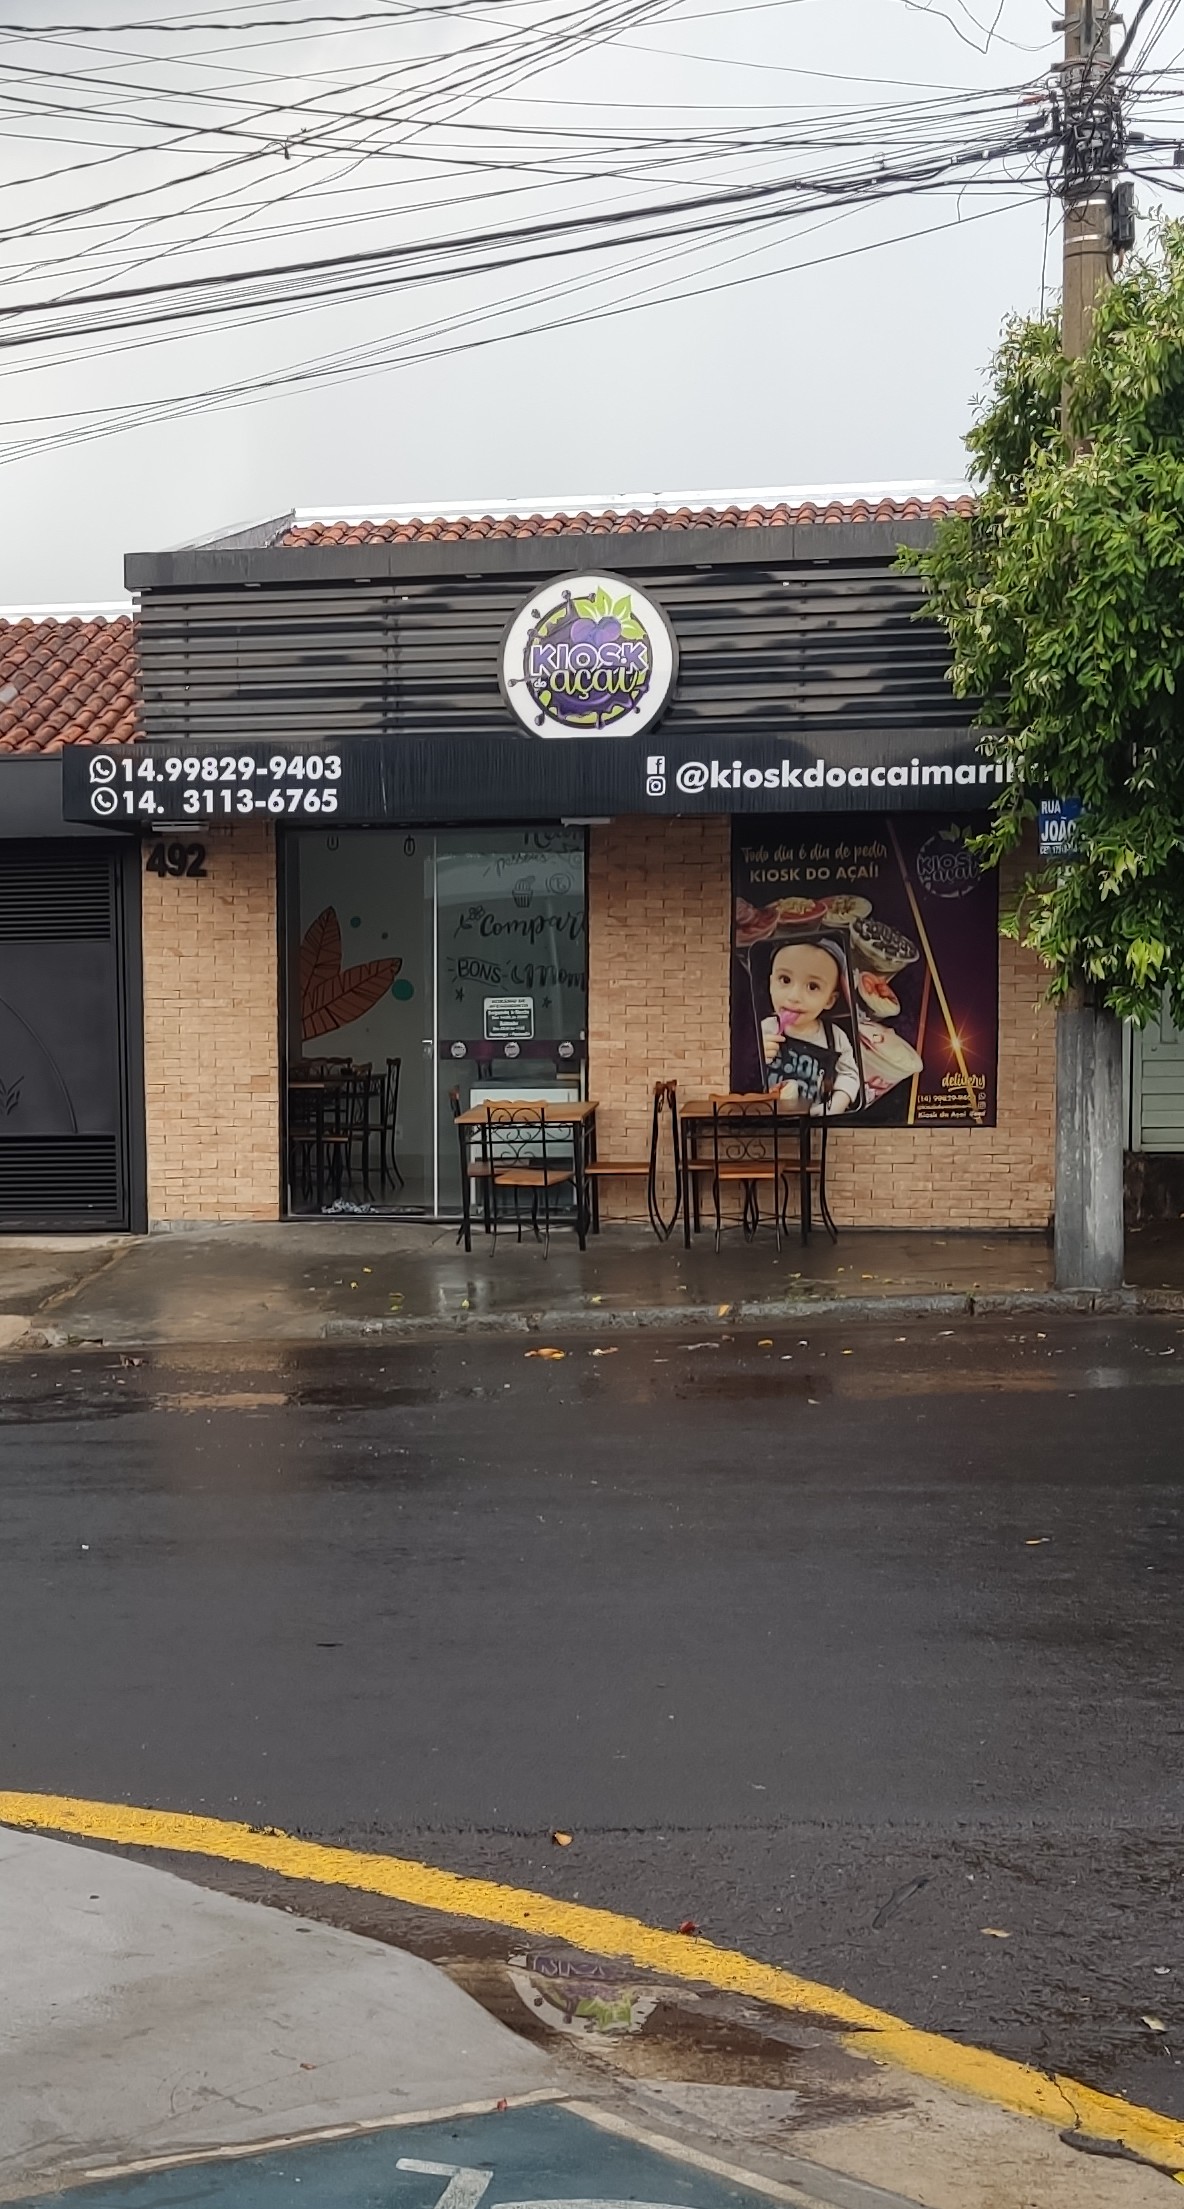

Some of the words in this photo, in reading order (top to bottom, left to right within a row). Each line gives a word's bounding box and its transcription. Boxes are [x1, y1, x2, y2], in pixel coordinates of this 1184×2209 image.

[530, 641, 649, 677] KIOSK
[121, 755, 342, 782] 14.99829-9403
[676, 756, 1049, 794] @kioskdoacaimaril
[122, 790, 165, 814] 14.
[183, 788, 338, 813] 3113-6765
[1041, 800, 1061, 814] RUA
[146, 843, 208, 878] 492
[741, 845, 769, 864] Todo
[774, 843, 793, 862] dia
[810, 842, 829, 861] dia
[835, 841, 850, 860] de
[853, 839, 888, 863] pedir
[750, 867, 800, 883] KIOSK
[806, 867, 830, 881] DO
[457, 959, 501, 984] BONS
